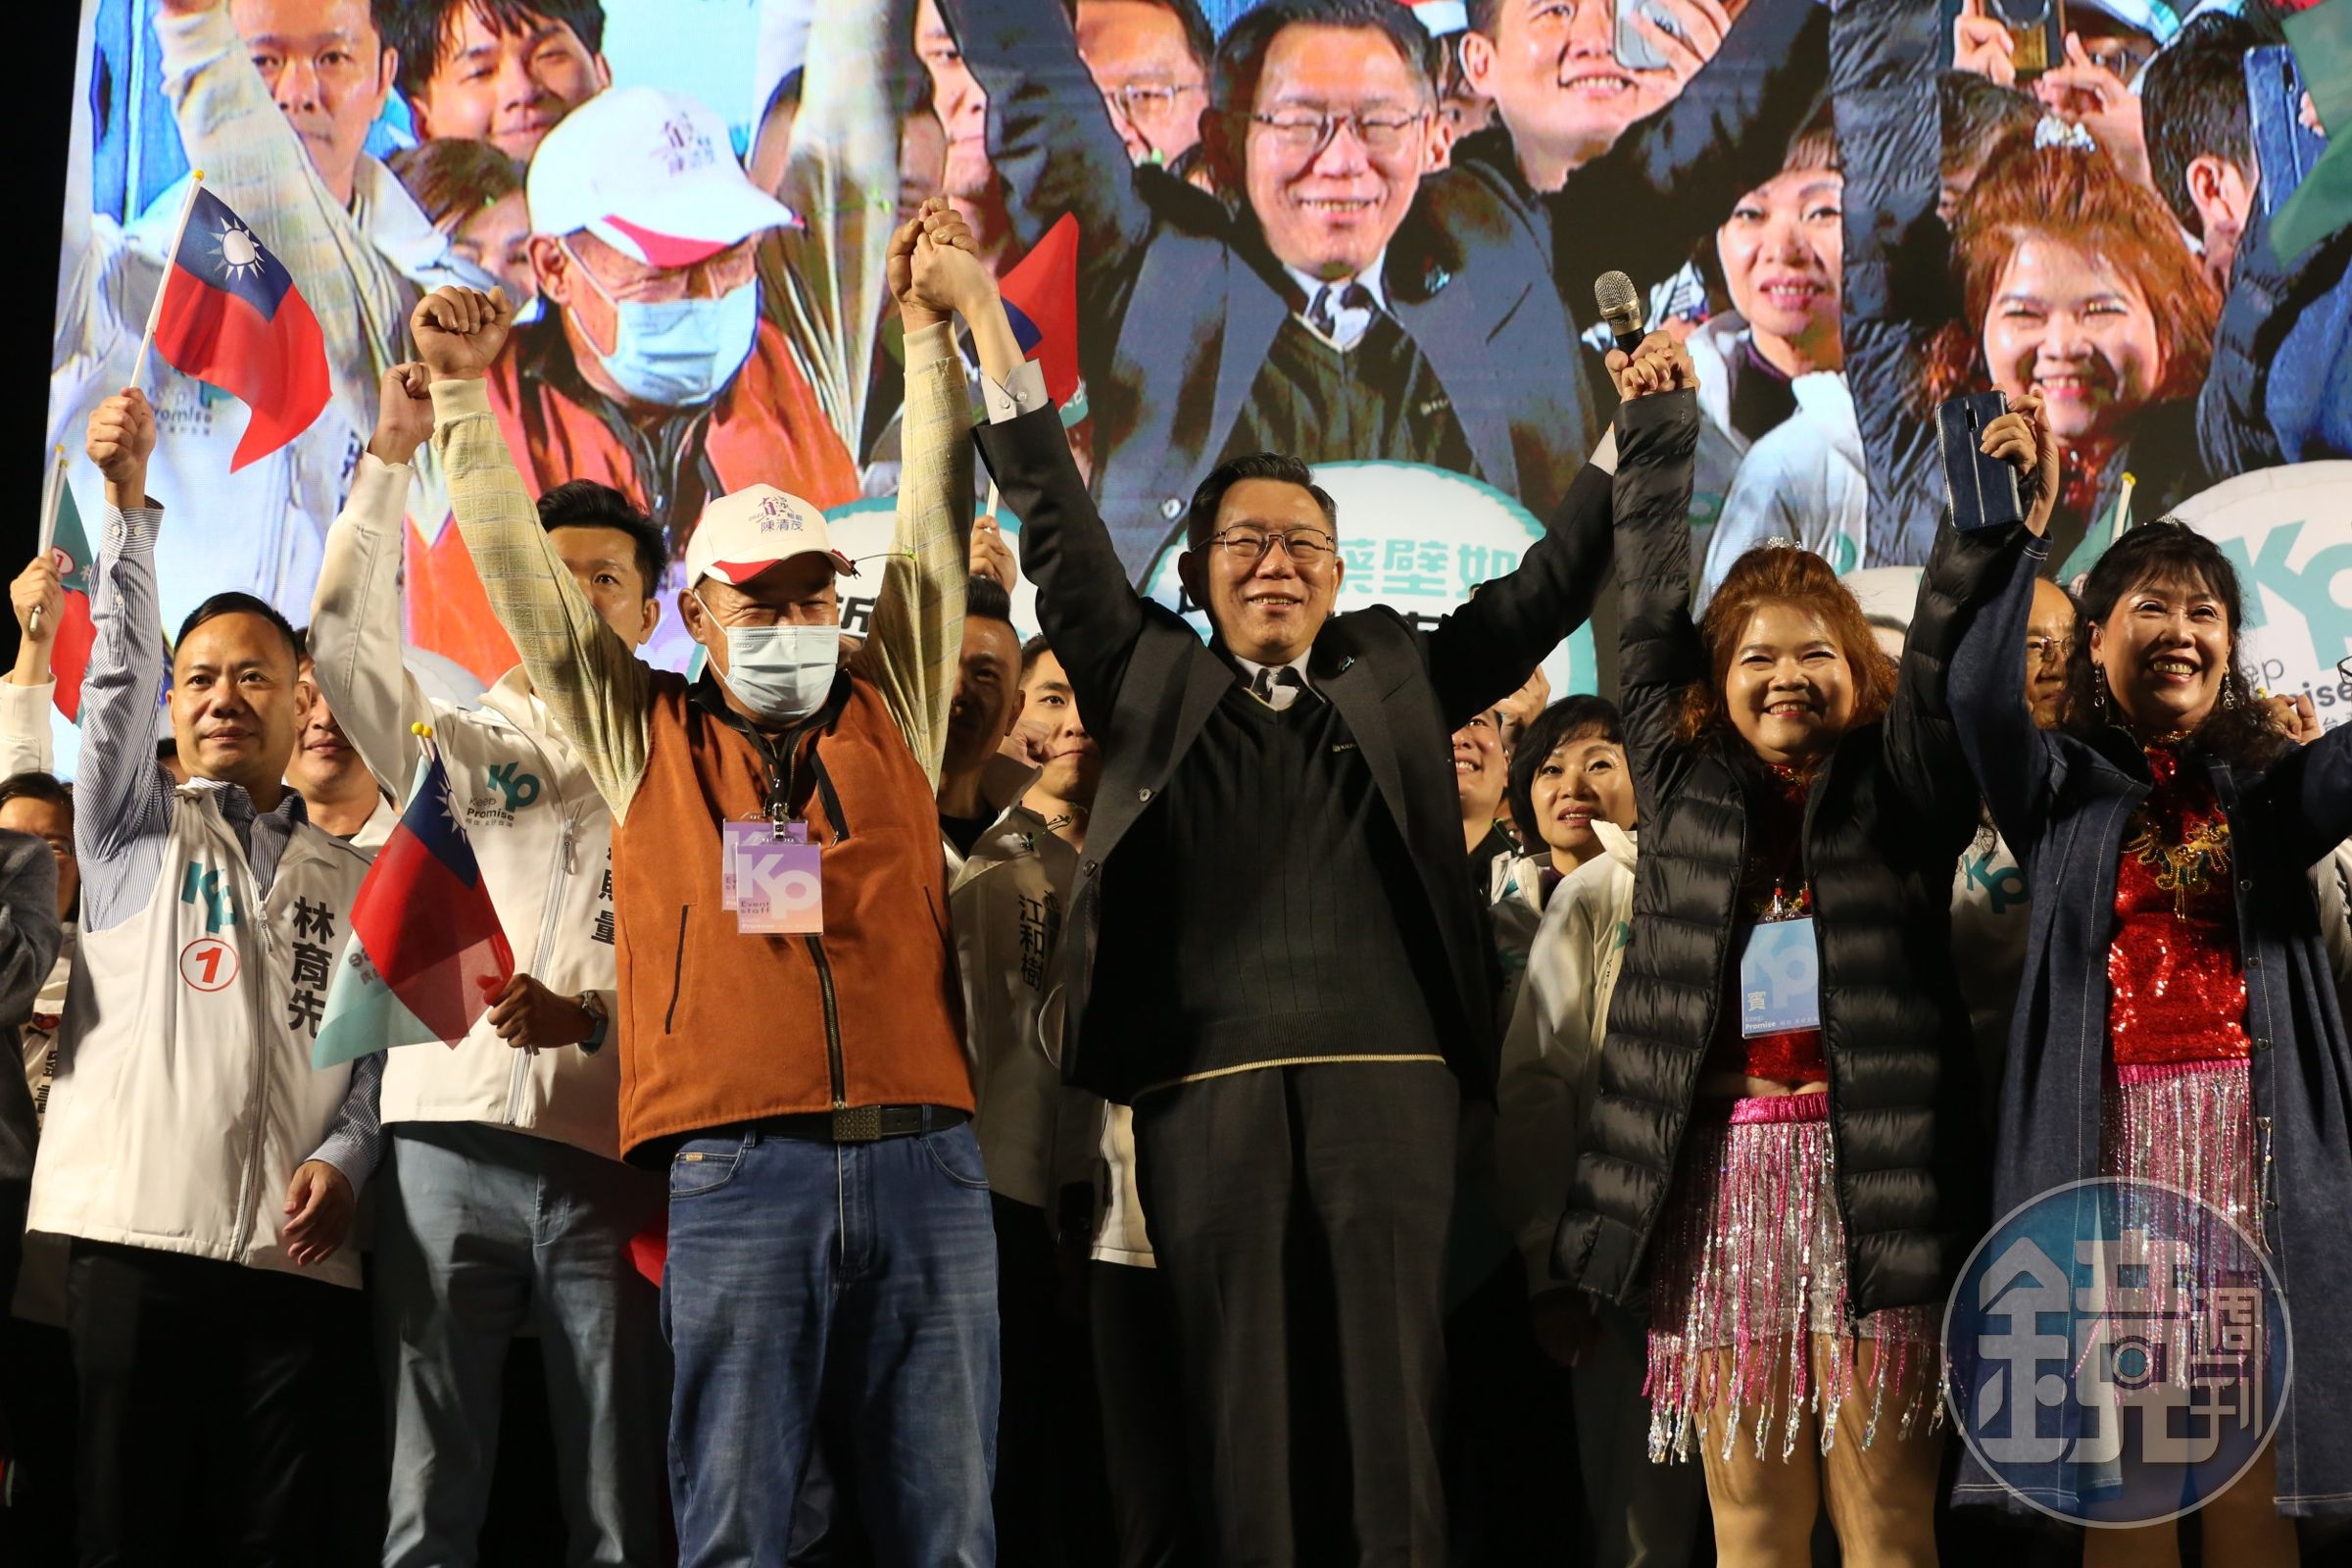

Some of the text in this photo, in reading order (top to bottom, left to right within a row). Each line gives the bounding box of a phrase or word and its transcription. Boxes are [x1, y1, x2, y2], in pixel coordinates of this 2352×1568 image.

[466, 808, 514, 821] Promise
[288, 895, 335, 1039] 林育先
[1744, 1020, 1777, 1031] Promise
